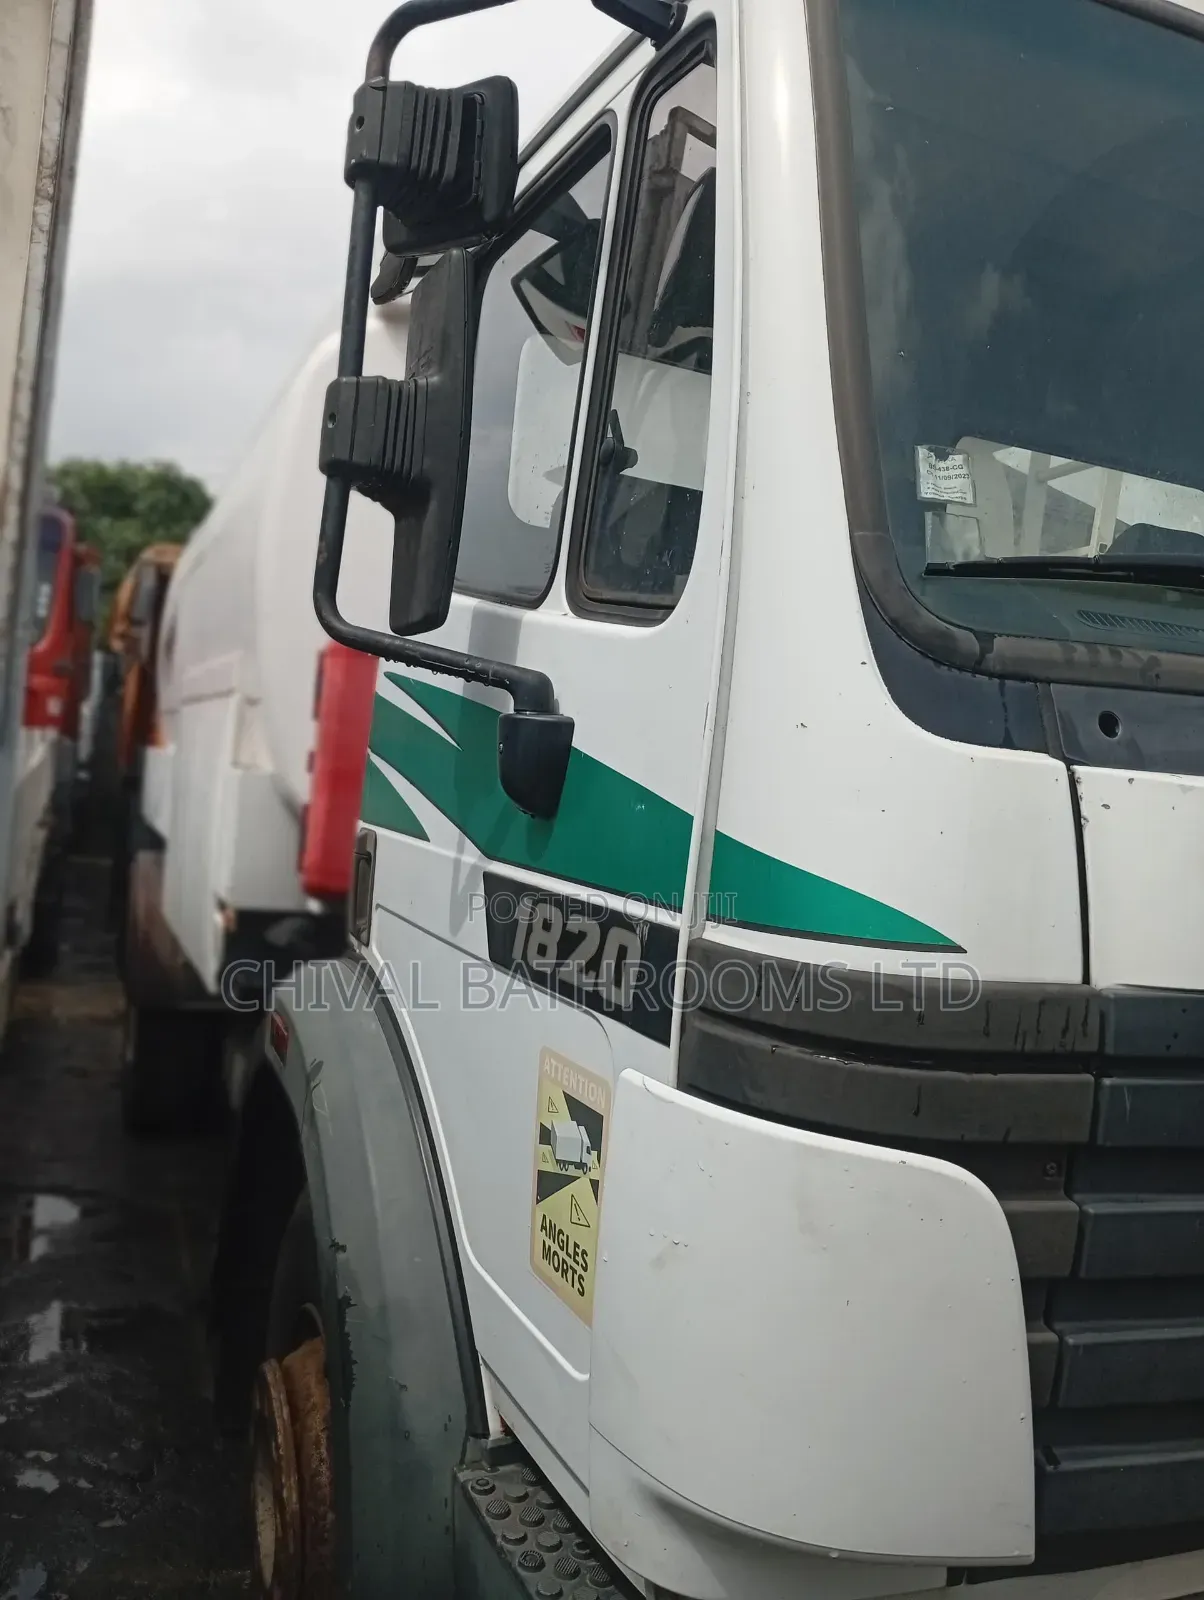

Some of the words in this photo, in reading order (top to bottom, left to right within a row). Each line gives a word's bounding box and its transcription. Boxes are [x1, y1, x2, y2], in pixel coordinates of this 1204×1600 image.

[511, 901, 643, 1009] 1820
[543, 1055, 606, 1110] ATTENTION
[539, 1212, 589, 1274] ANGLES
[541, 1238, 586, 1298] MORTS
